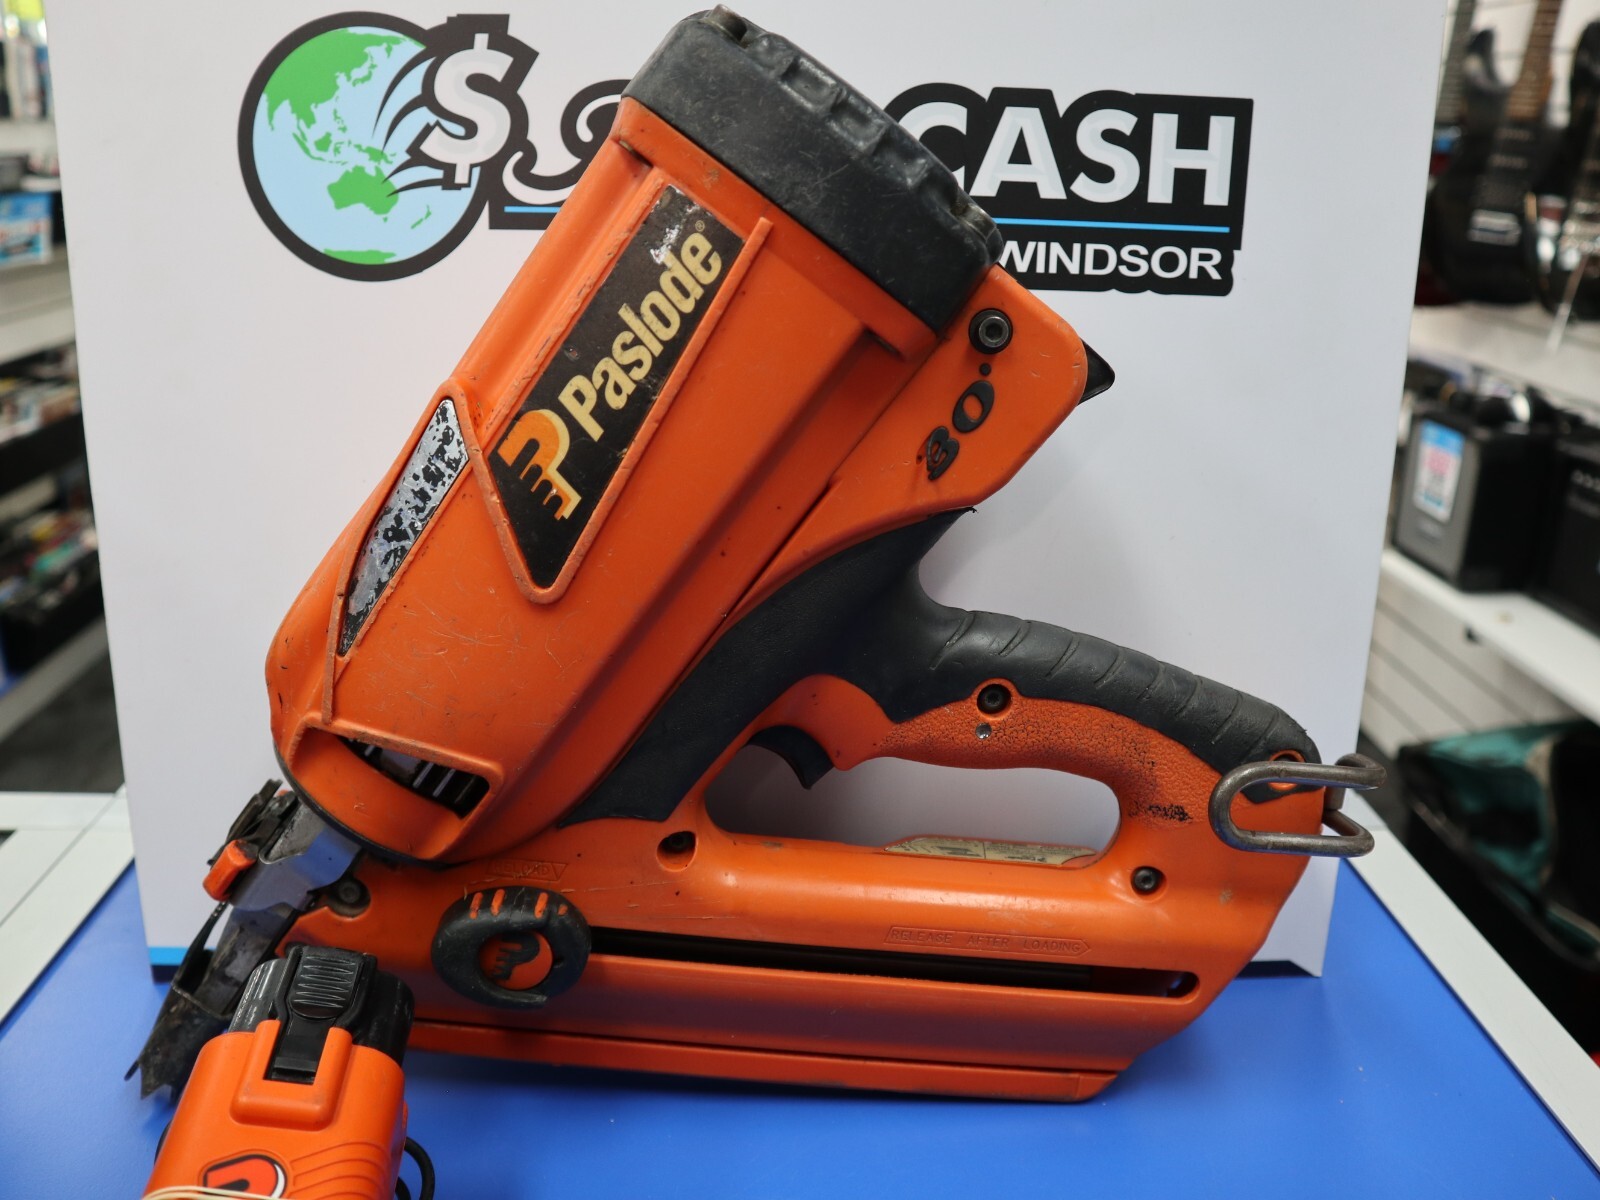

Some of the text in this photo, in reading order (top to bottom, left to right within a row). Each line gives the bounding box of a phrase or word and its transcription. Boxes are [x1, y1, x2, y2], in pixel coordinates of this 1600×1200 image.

[1000, 240, 1223, 281] WINDSOR
[557, 232, 723, 442] Paslode
[890, 929, 1082, 954] RELEASE AFTER LOADING
